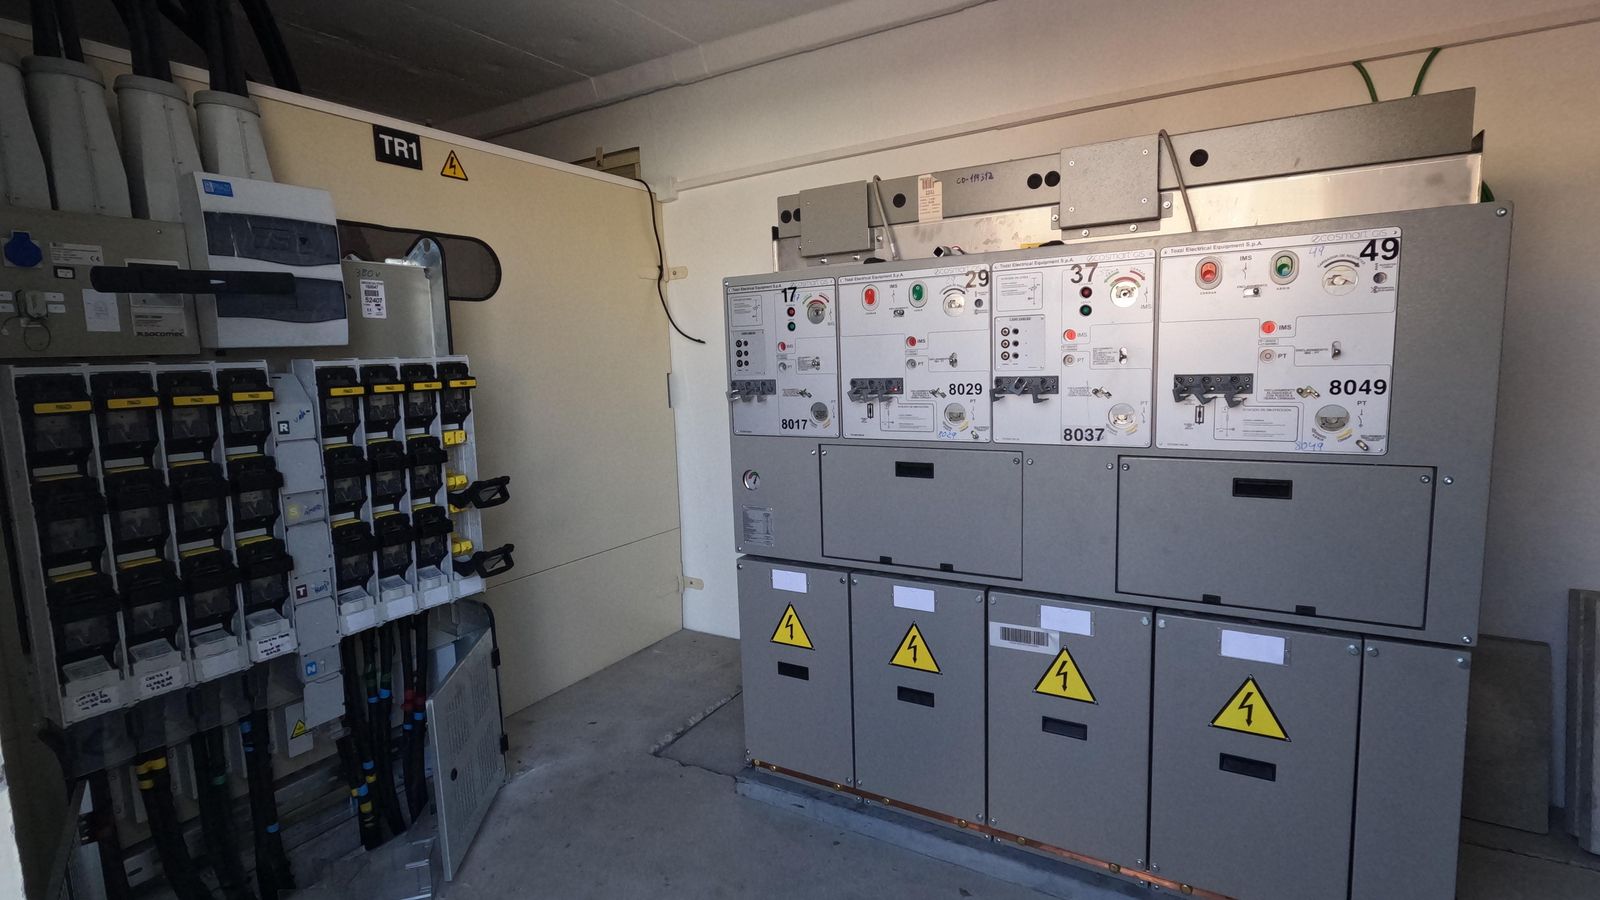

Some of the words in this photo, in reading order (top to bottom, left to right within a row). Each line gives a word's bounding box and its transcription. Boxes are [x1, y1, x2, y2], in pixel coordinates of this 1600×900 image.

[379, 134, 418, 161] TR1
[1213, 243, 1245, 251] Equipment
[1360, 238, 1400, 262] 49
[965, 269, 989, 289] 29
[1070, 262, 1099, 284] 37
[781, 286, 798, 303] 17
[949, 383, 983, 396] 8029
[1329, 379, 1387, 396] 8049
[279, 422, 290, 433] R
[781, 418, 808, 430] 8017
[1063, 427, 1105, 442] 8037
[289, 507, 299, 517] S
[296, 586, 307, 597] T
[306, 662, 317, 674] N
